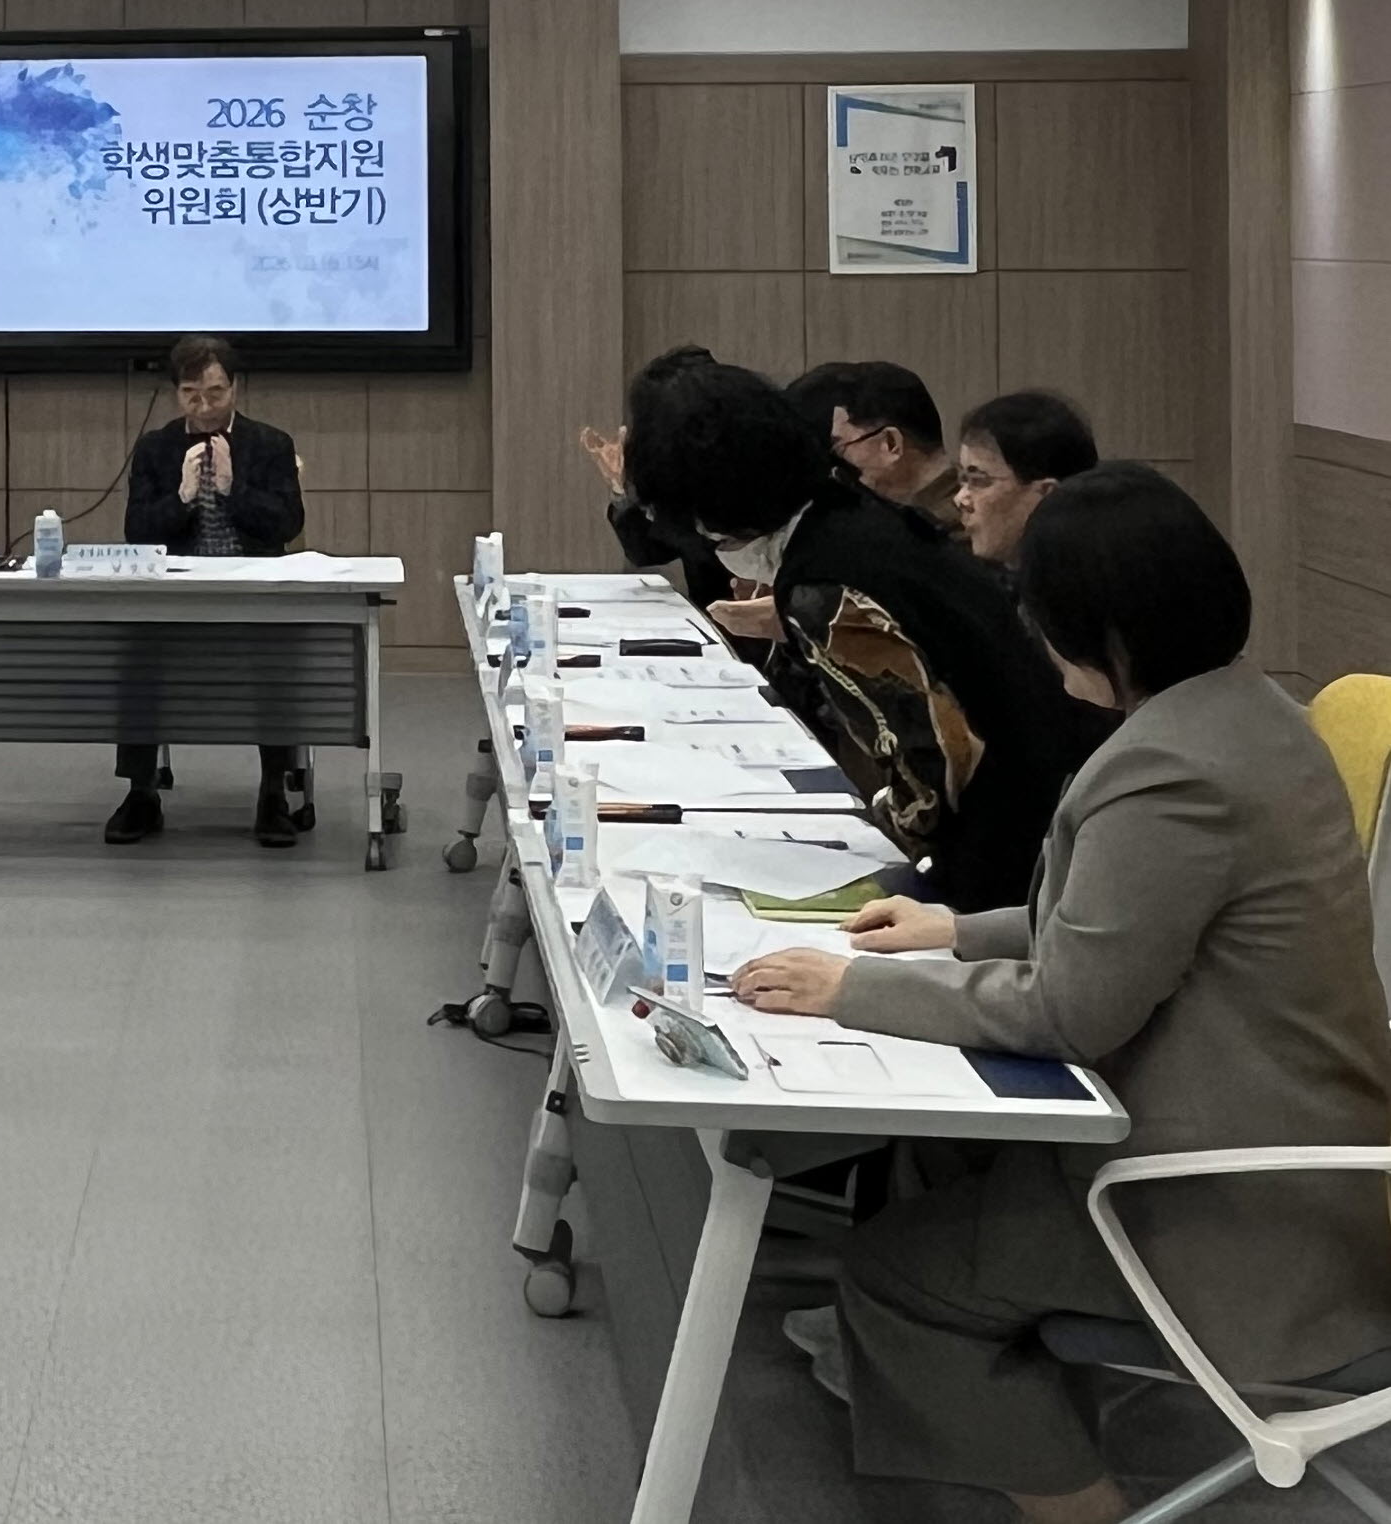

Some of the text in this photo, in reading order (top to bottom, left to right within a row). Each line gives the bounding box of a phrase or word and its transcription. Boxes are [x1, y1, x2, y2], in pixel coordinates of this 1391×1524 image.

[206, 93, 377, 131] 2026 순창
[100, 140, 384, 179] 학생맞춤통합지원
[141, 186, 386, 225] 위원회 (상반기)
